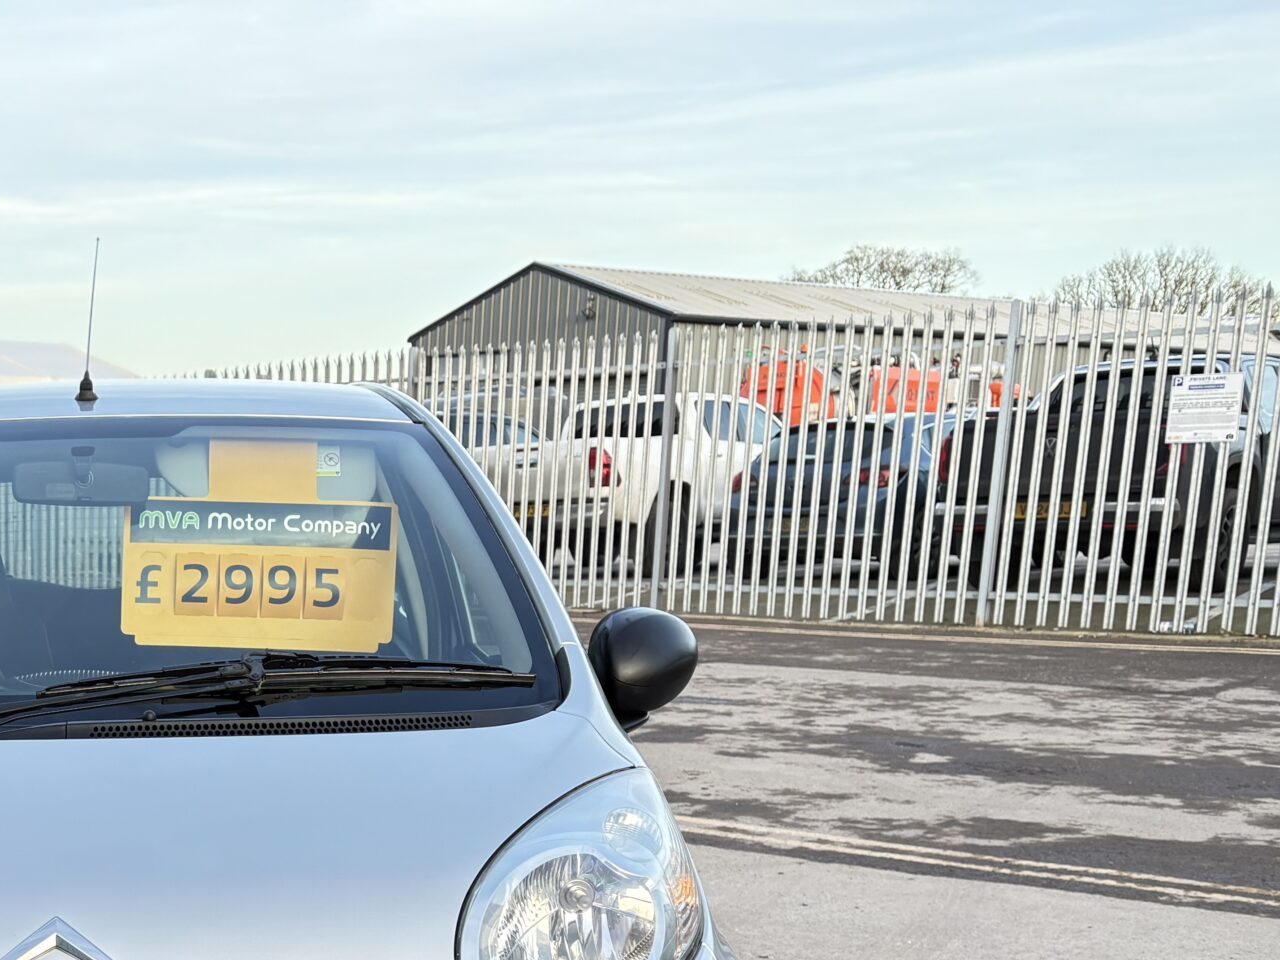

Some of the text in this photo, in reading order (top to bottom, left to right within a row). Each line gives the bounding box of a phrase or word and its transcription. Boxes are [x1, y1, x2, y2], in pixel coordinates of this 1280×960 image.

[138, 509, 382, 540] MVA Motor Company
[134, 563, 341, 608] £2995
